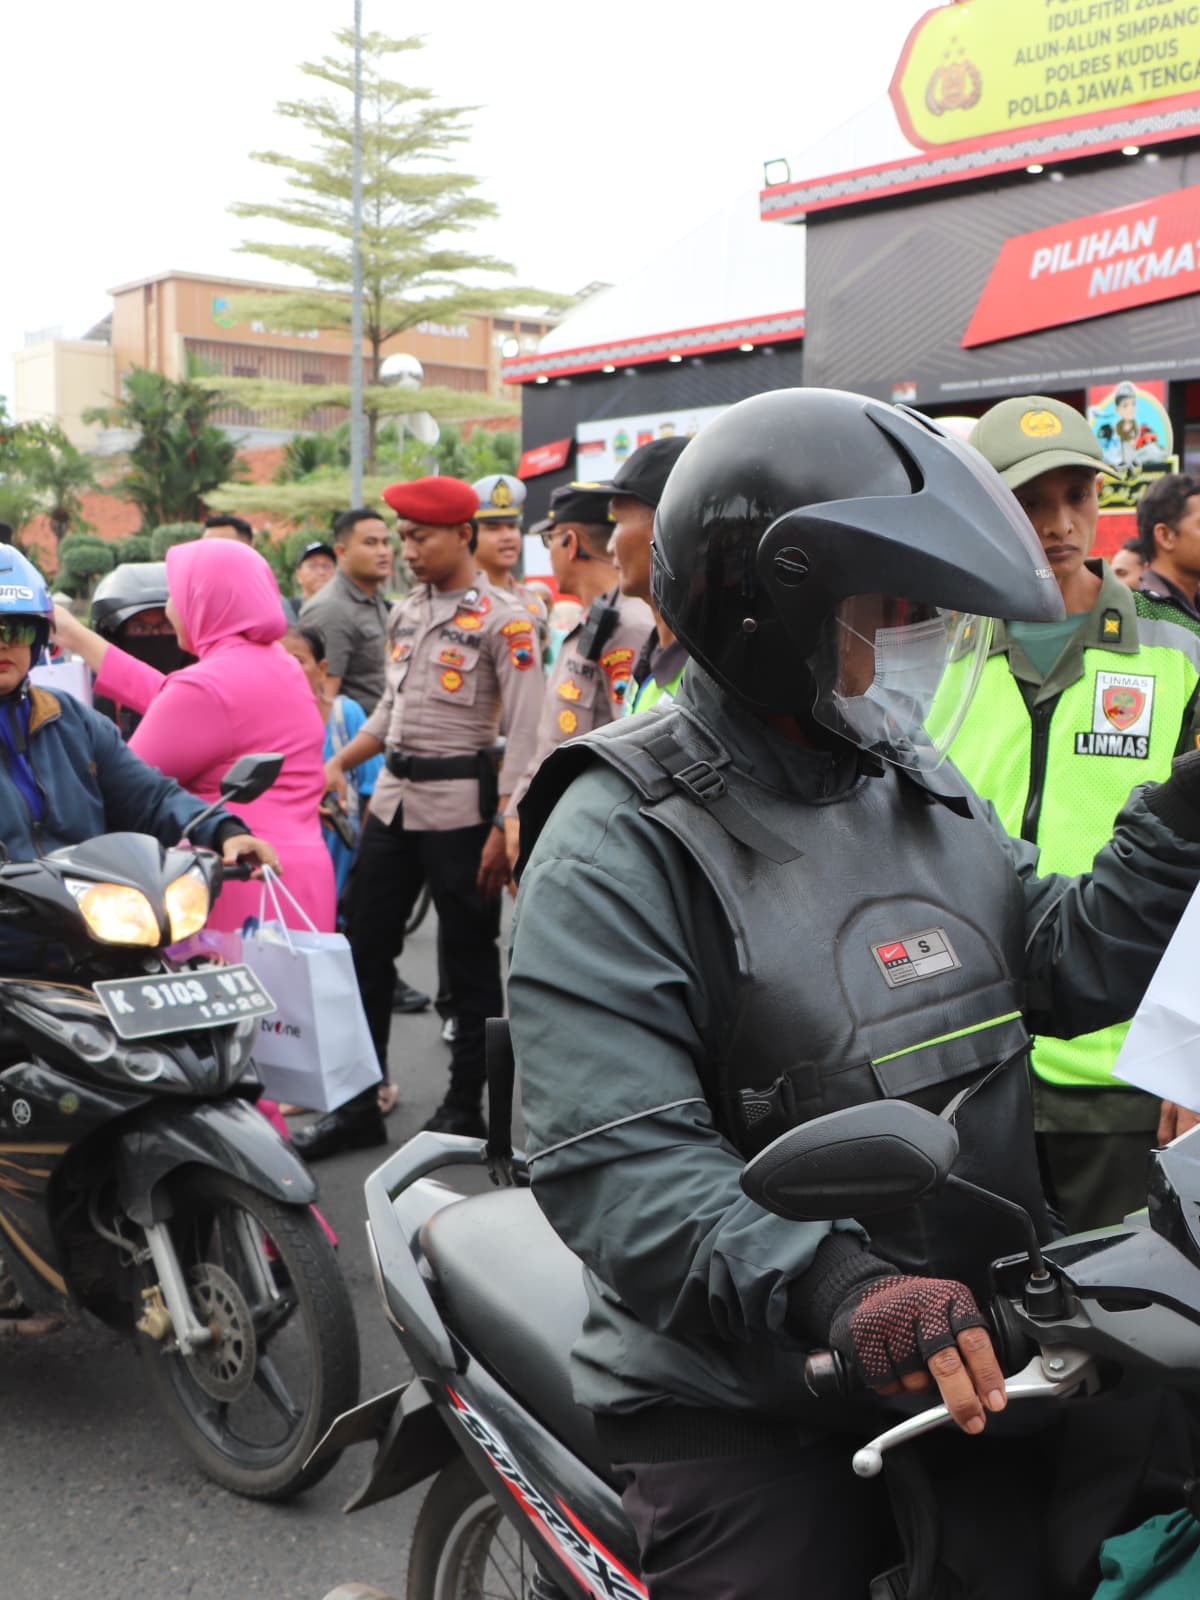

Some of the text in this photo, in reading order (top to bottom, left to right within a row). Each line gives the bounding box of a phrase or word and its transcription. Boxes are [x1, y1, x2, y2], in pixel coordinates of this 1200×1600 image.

[1014, 27, 1112, 67] ALUN-ALUN
[1116, 6, 1200, 42] SIMPANG
[1047, 0, 1130, 32] IDULFITRI
[1046, 38, 1180, 84] POLRES KUDUS
[1008, 90, 1071, 119] POLDA
[1077, 75, 1134, 105] JAWA
[1029, 216, 1157, 279] PILIHAN
[1102, 676, 1149, 688] LINMAS
[1077, 733, 1148, 758] LINMAS
[917, 940, 930, 953] S
[109, 970, 254, 1014] K 3103 VI
